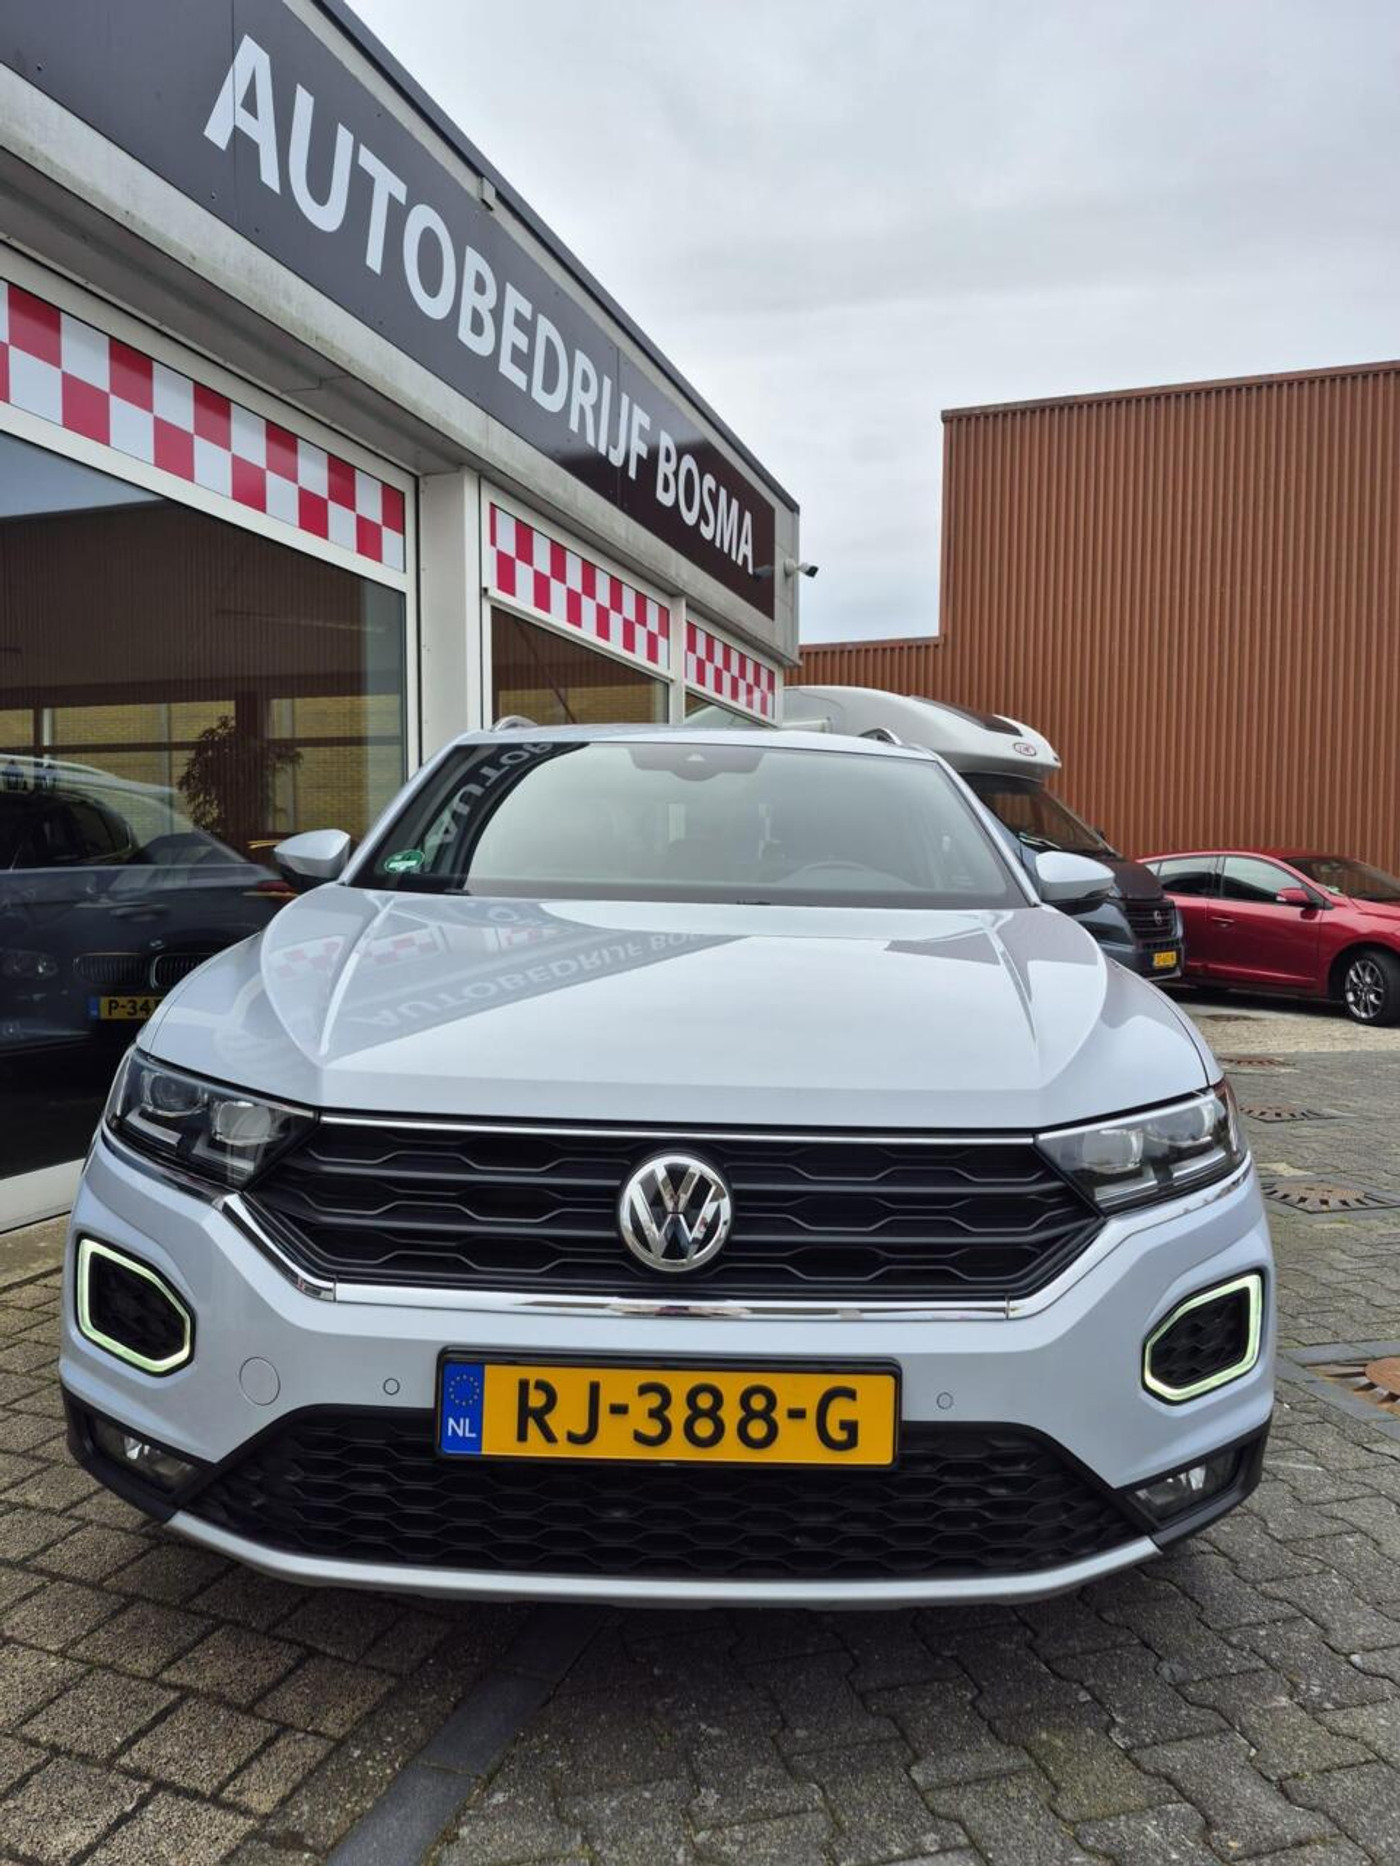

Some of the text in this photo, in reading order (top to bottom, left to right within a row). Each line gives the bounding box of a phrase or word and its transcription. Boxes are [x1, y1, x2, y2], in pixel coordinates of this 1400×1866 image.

[204, 33, 753, 575] AUTOBEDRIJF BOSMA
[447, 1378, 859, 1451] NL RJ-388-G
